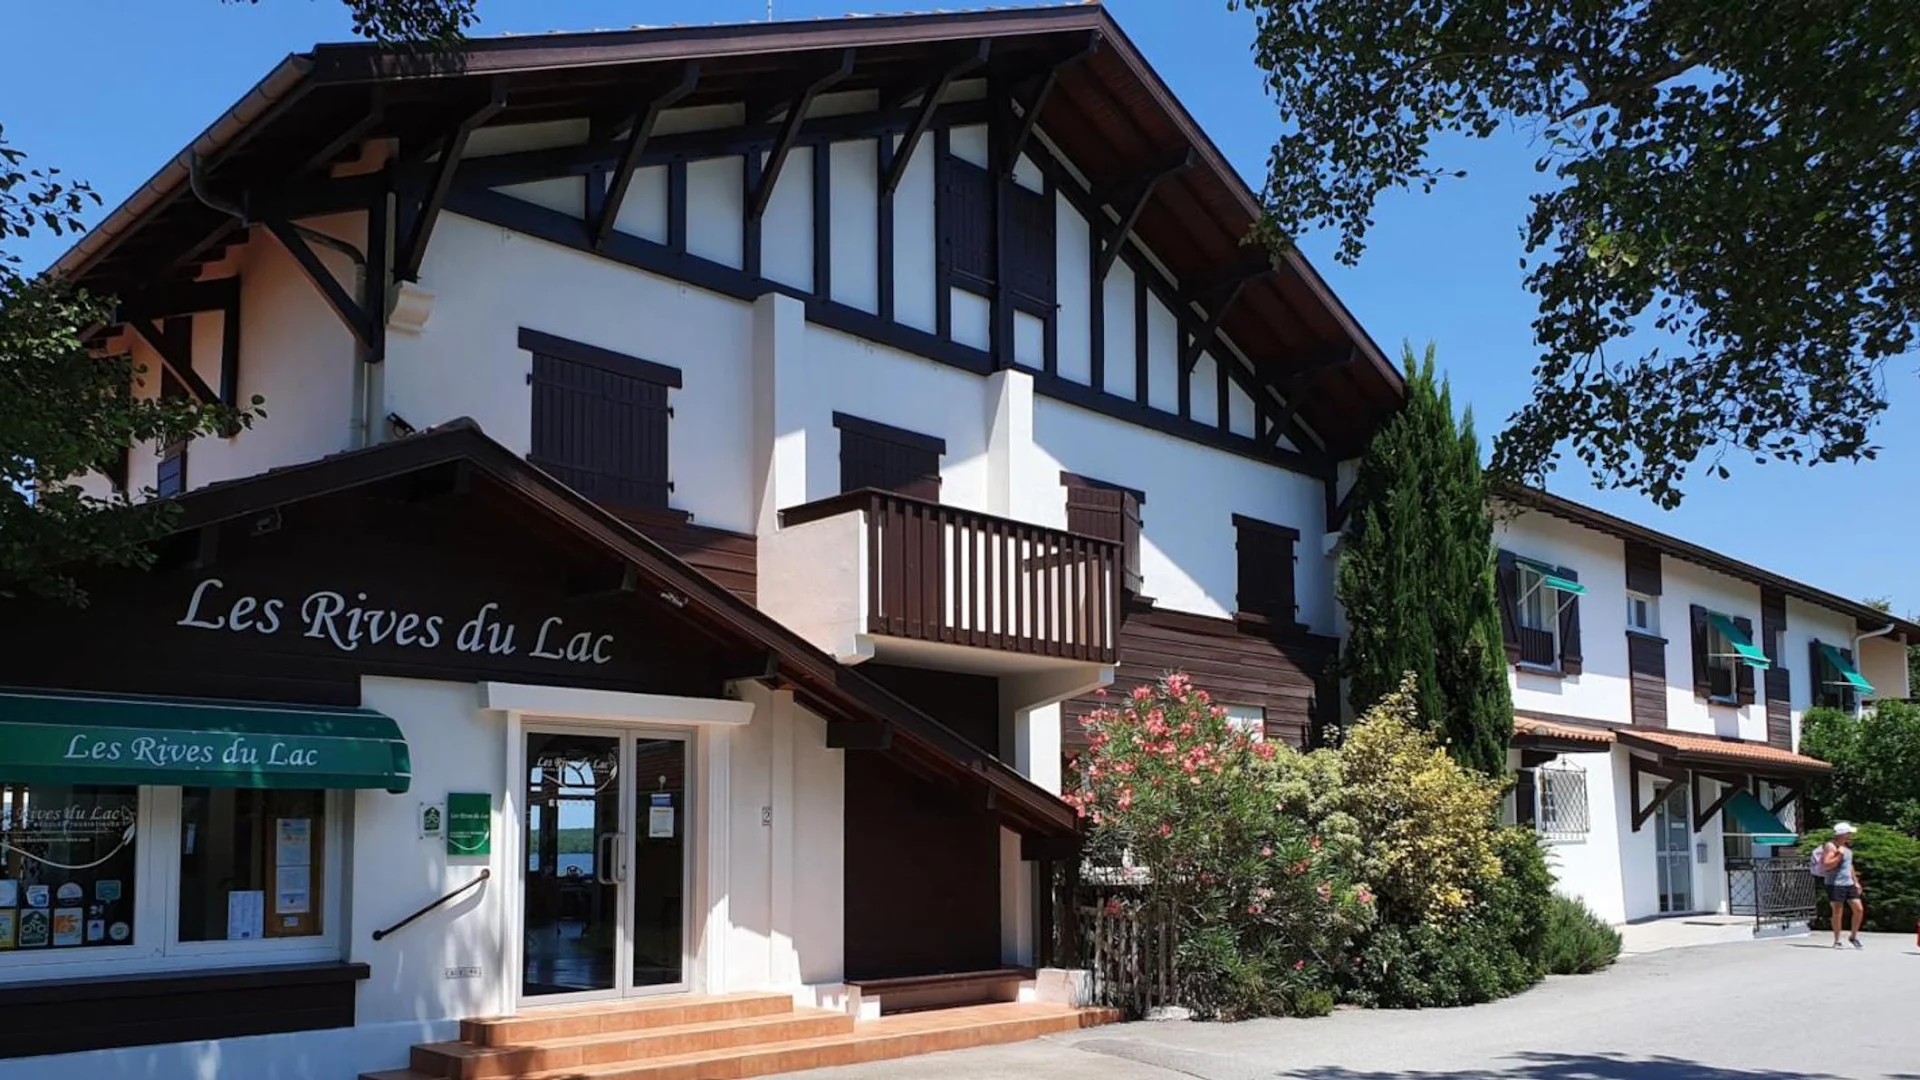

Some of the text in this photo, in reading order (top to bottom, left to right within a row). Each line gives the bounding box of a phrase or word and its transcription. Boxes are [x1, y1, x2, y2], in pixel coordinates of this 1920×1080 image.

[177, 578, 614, 664] Les Rives du Lac
[64, 734, 318, 767] Les Rives du Lac
[90, 806, 120, 820] Lac
